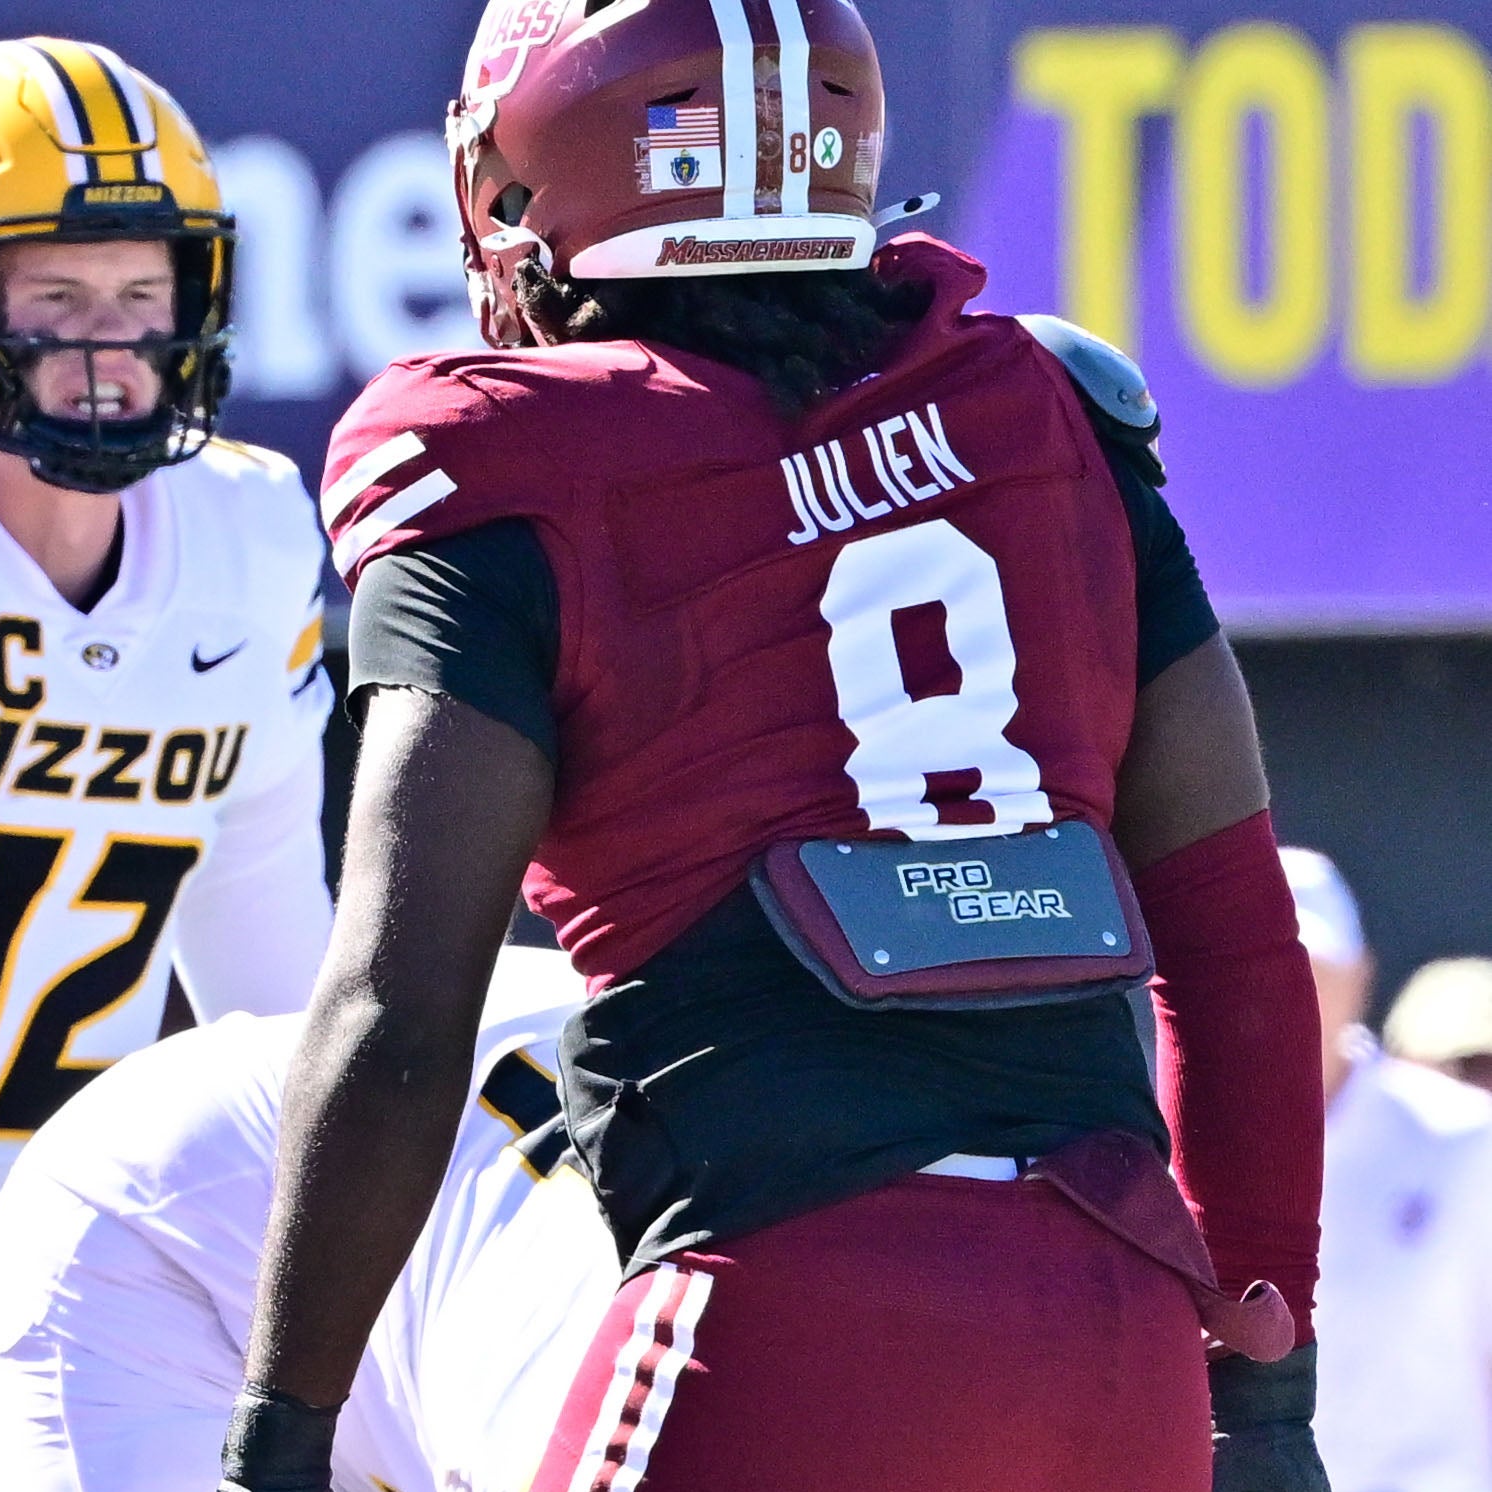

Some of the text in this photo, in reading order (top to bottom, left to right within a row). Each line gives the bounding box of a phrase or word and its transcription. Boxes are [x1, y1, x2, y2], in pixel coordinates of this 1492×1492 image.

[788, 132, 807, 174] 8
[655, 235, 856, 267] MASSACHUSETTS
[779, 402, 977, 546] JULIEN
[818, 518, 1054, 842] 8
[896, 860, 993, 897] PRO
[948, 889, 1073, 925] GEAR
